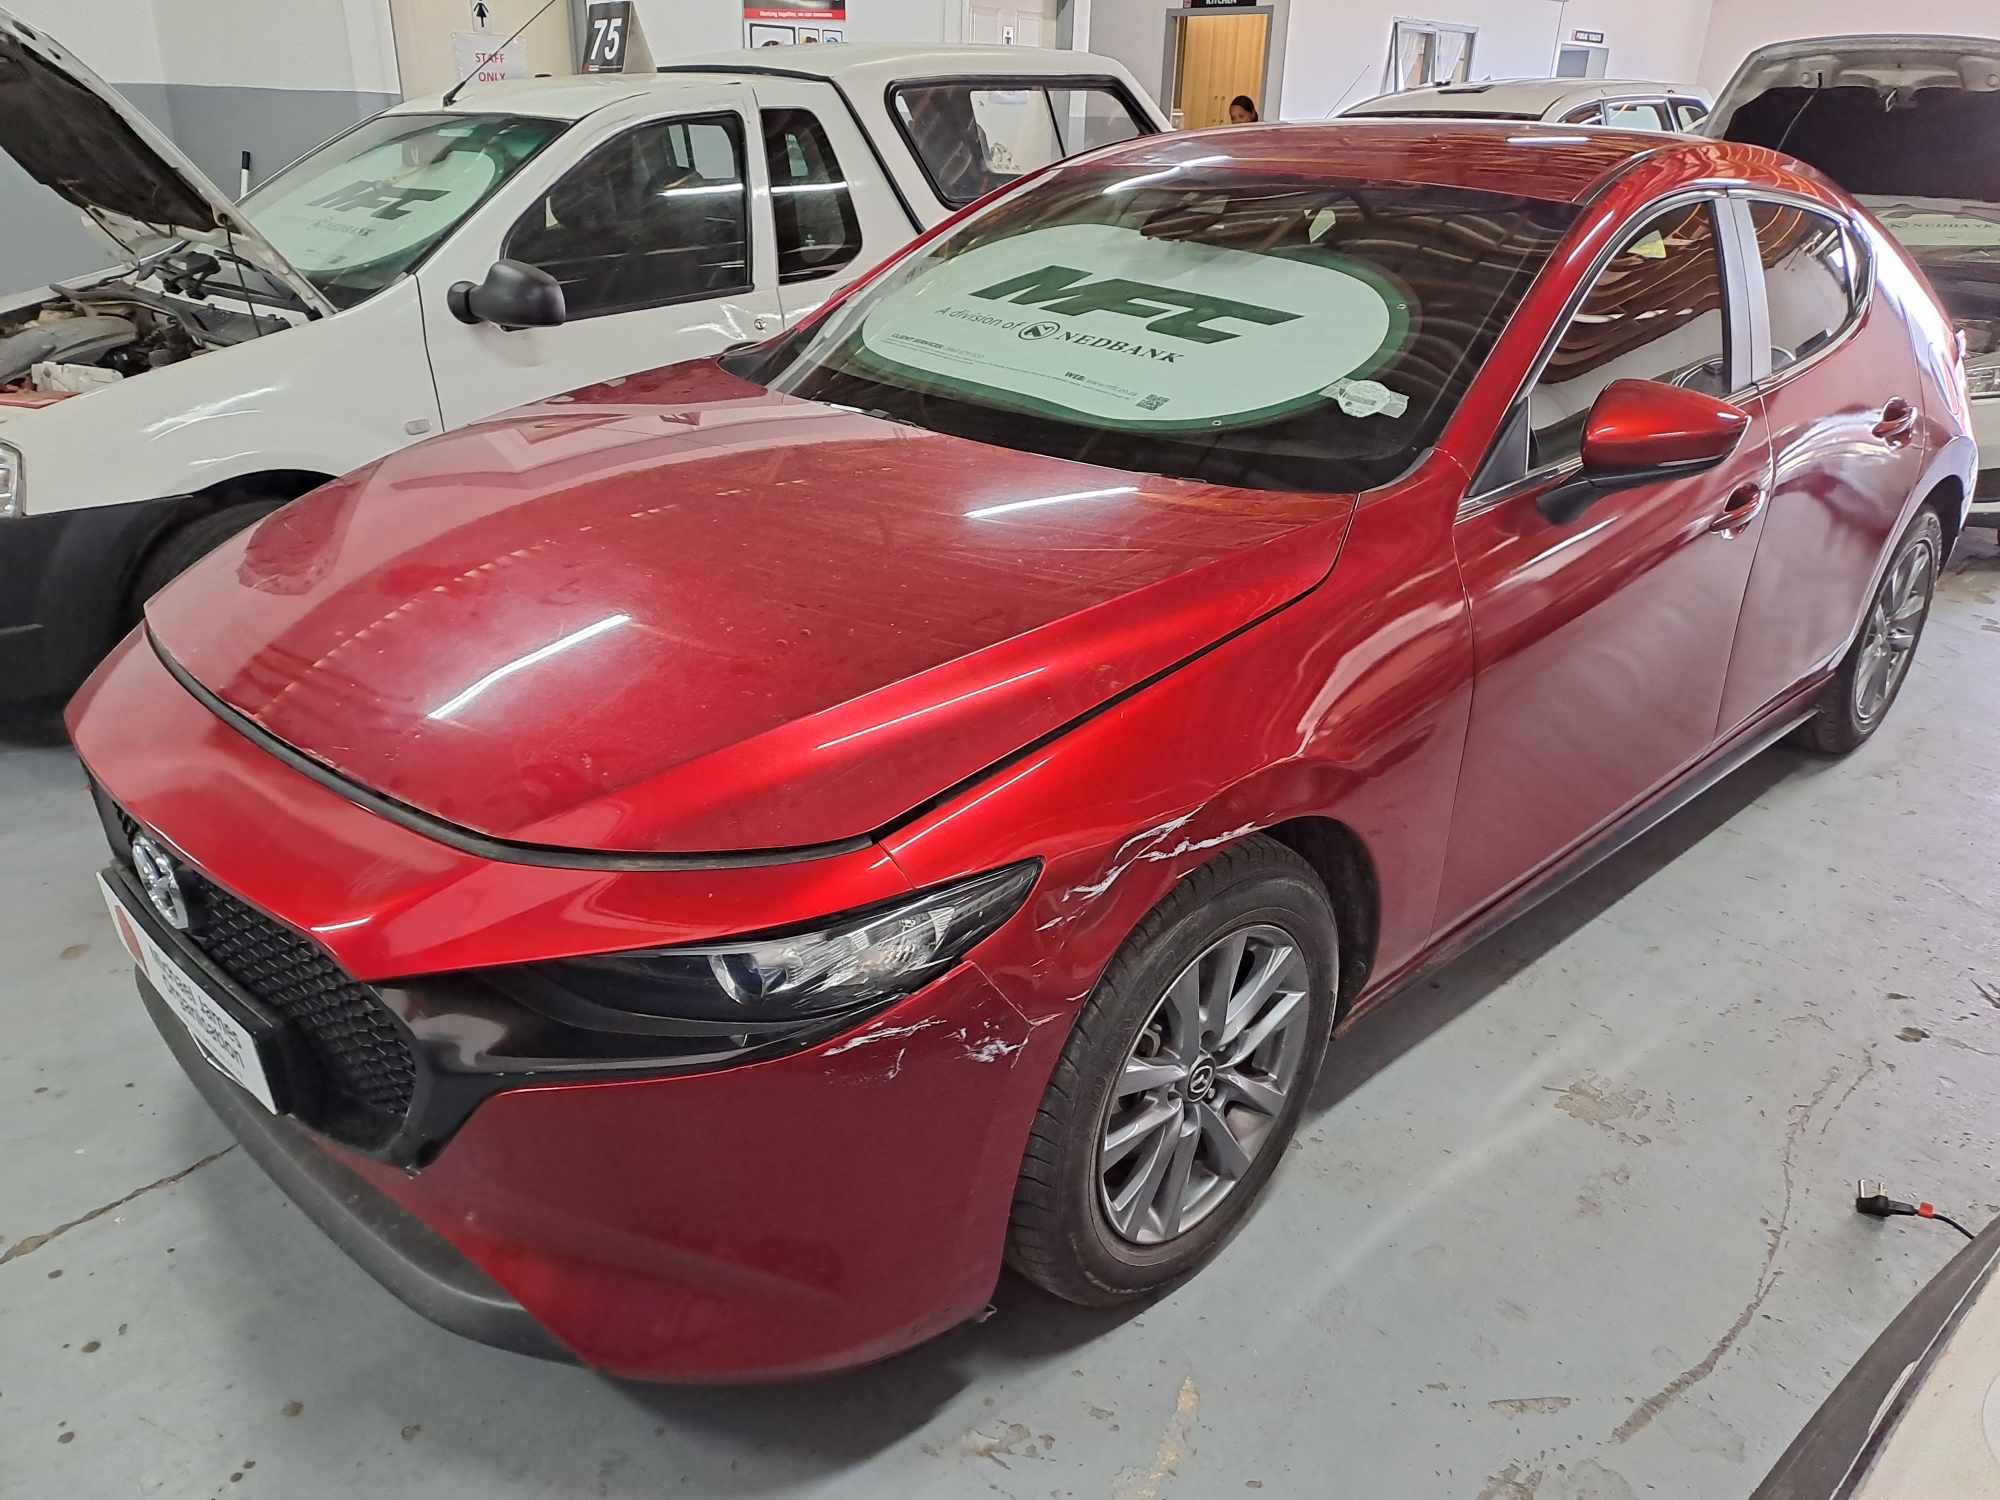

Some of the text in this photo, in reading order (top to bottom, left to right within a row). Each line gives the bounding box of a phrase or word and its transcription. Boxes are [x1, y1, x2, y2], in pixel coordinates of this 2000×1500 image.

[475, 52, 505, 64] STAFF
[590, 17, 623, 60] 75
[478, 71, 506, 82] ONLY
[968, 265, 1305, 344] MFC
[948, 308, 1002, 327] division
[1001, 321, 1027, 329] of
[1054, 331, 1185, 363] NEDBANK
